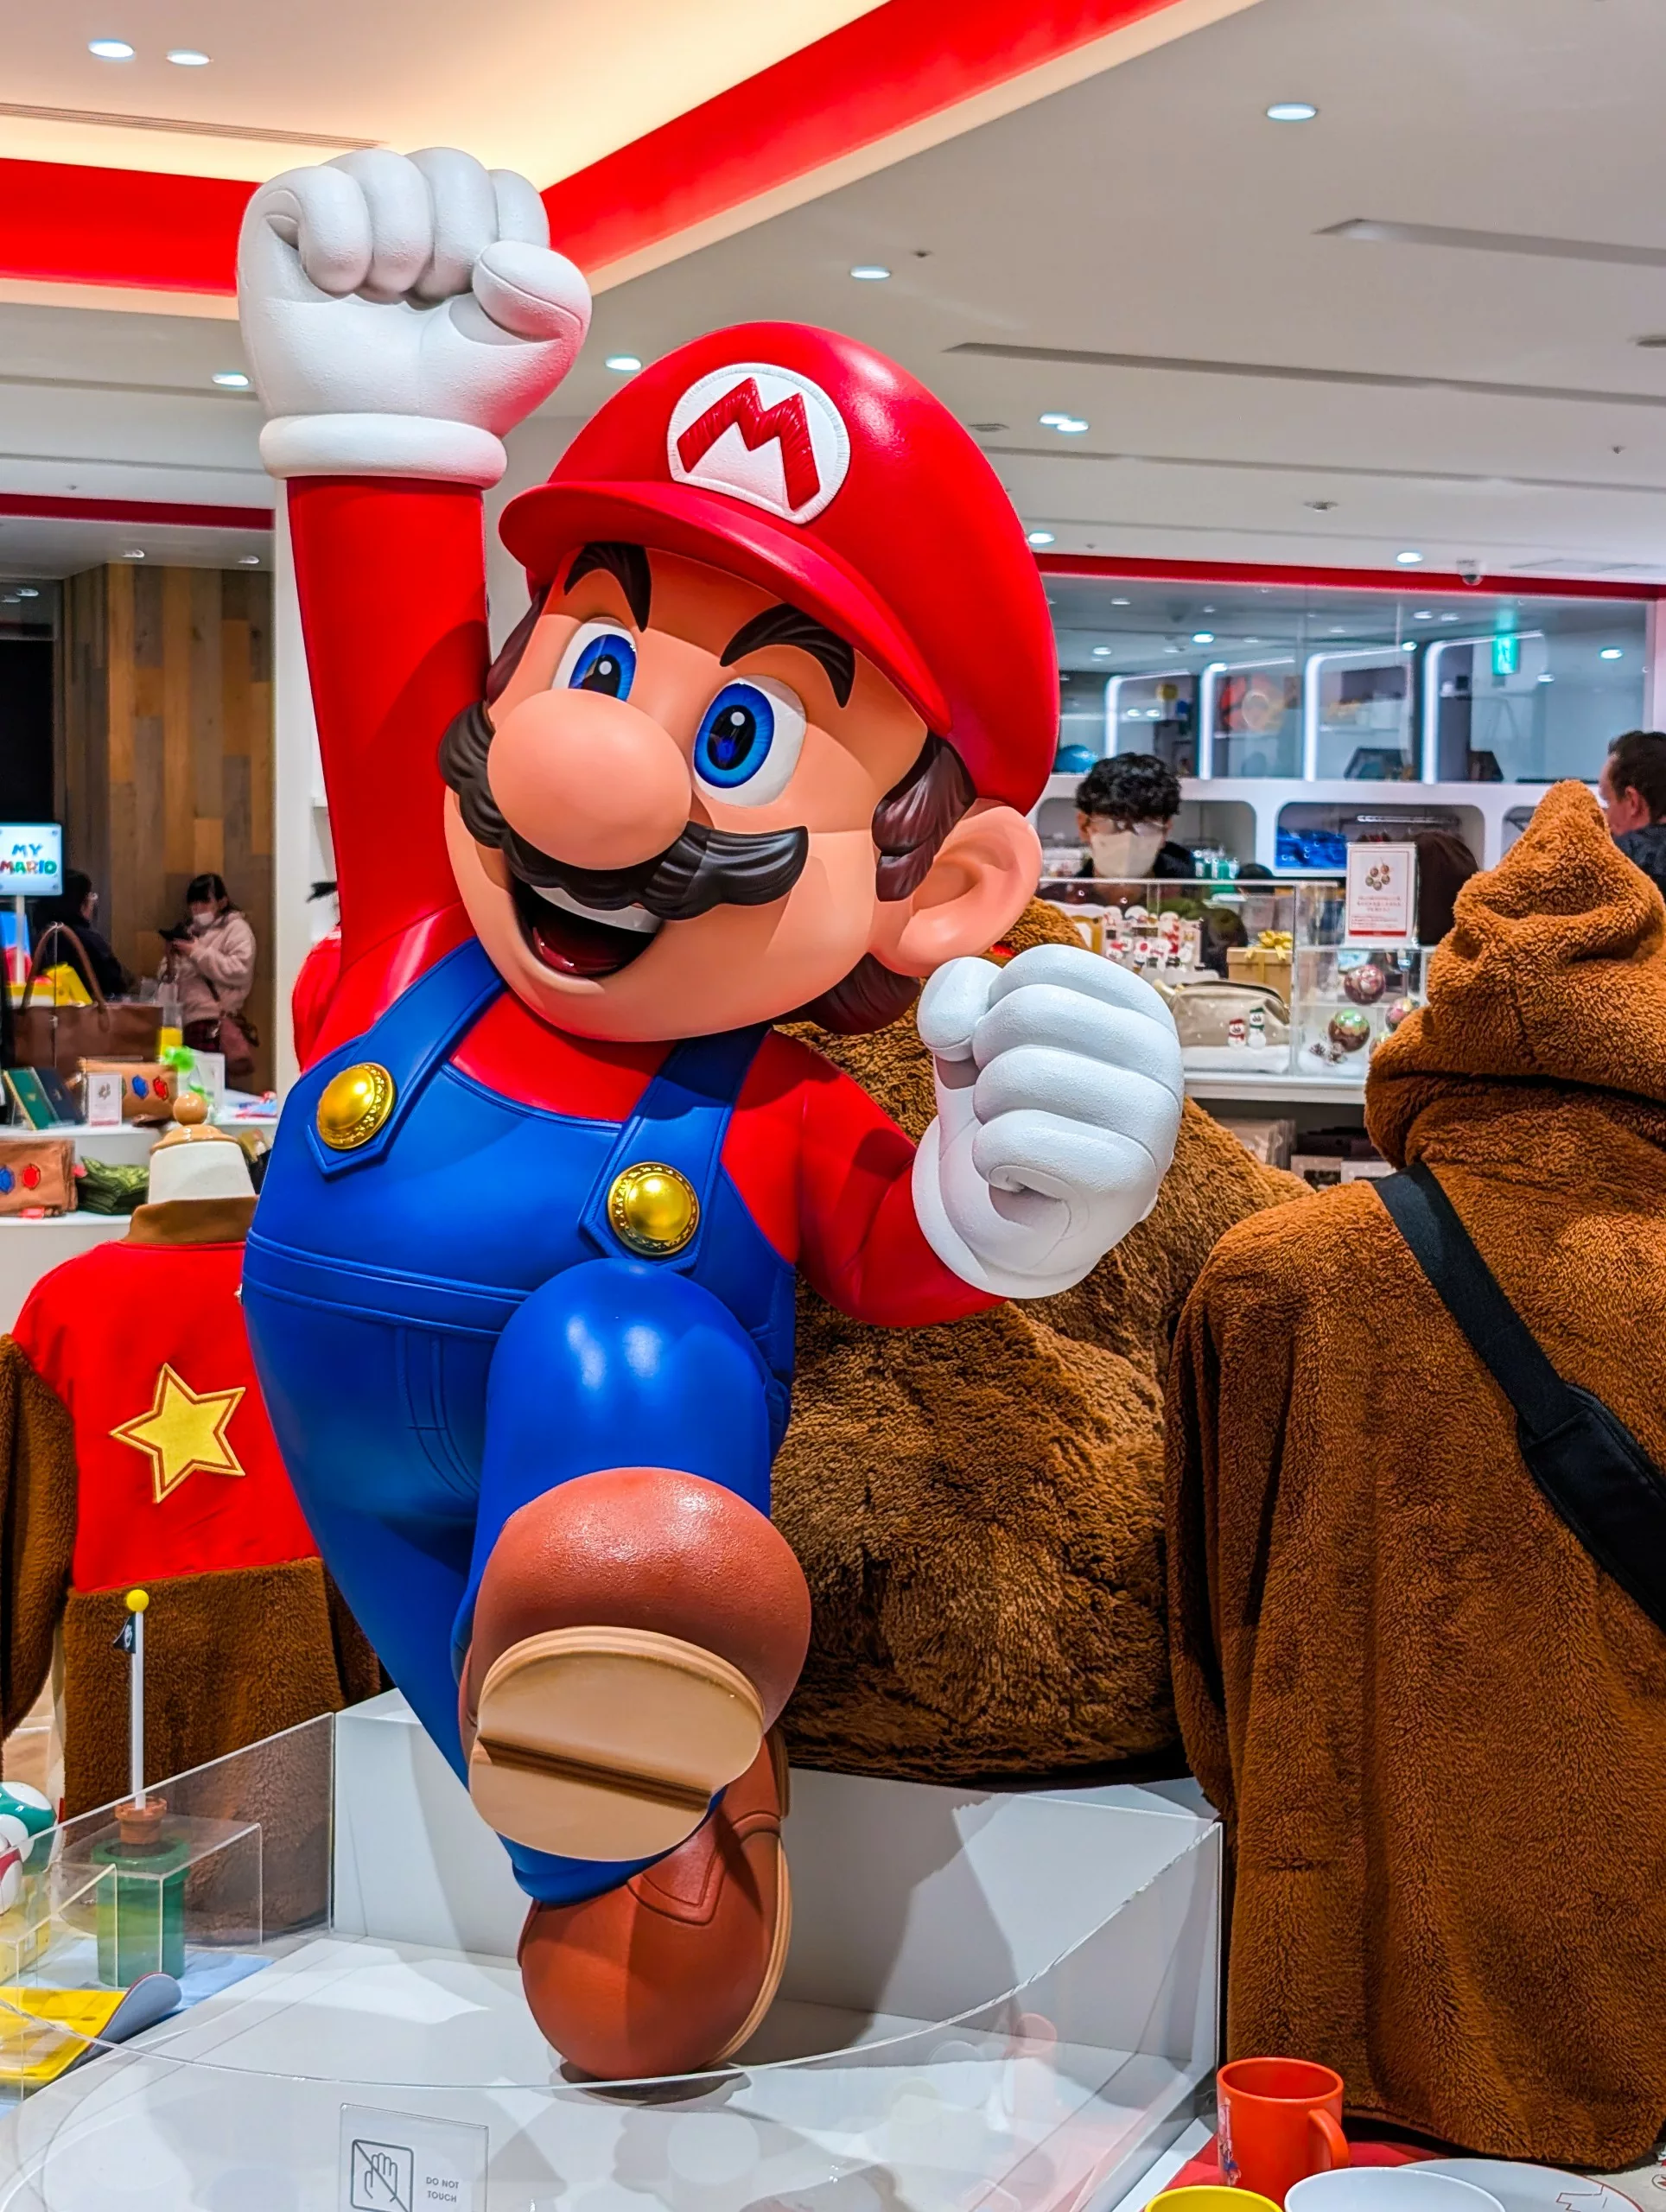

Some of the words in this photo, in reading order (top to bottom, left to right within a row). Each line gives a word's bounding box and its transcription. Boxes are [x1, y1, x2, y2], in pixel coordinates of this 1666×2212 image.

[677, 377, 821, 511] M
[11, 843, 43, 856] MY
[0, 860, 57, 874] MARIO
[426, 2177, 439, 2186] DO
[442, 2180, 460, 2190] NOT
[428, 2190, 457, 2202] TOUCH
